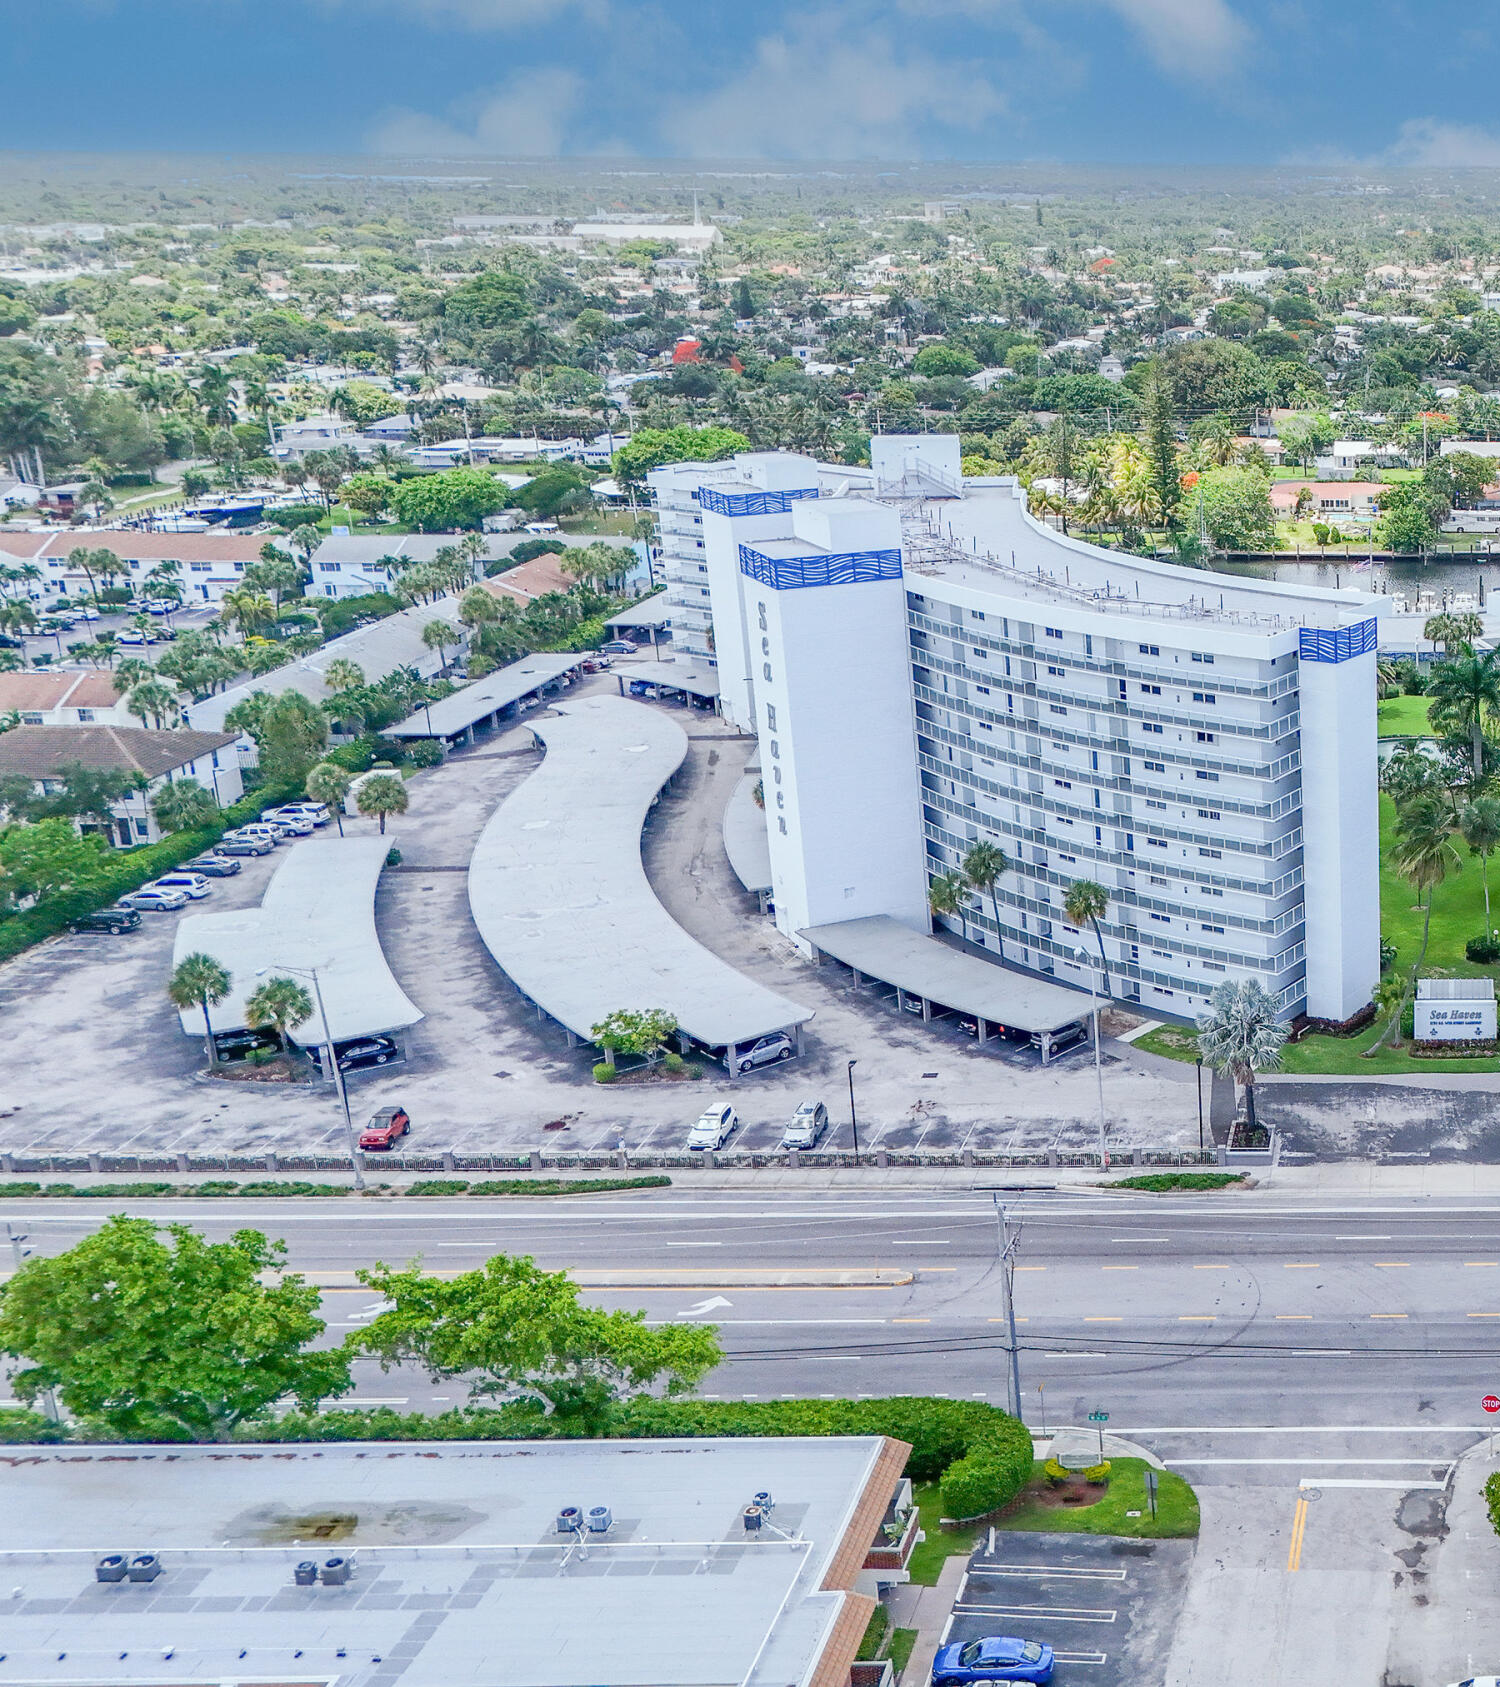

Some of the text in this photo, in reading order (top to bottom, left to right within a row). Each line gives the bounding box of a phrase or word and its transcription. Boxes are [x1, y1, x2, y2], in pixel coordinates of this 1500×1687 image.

[757, 601, 788, 836] Sea Haven
[1430, 1010, 1482, 1020] Sea Haven
[1482, 1400, 1500, 1408] STOP
